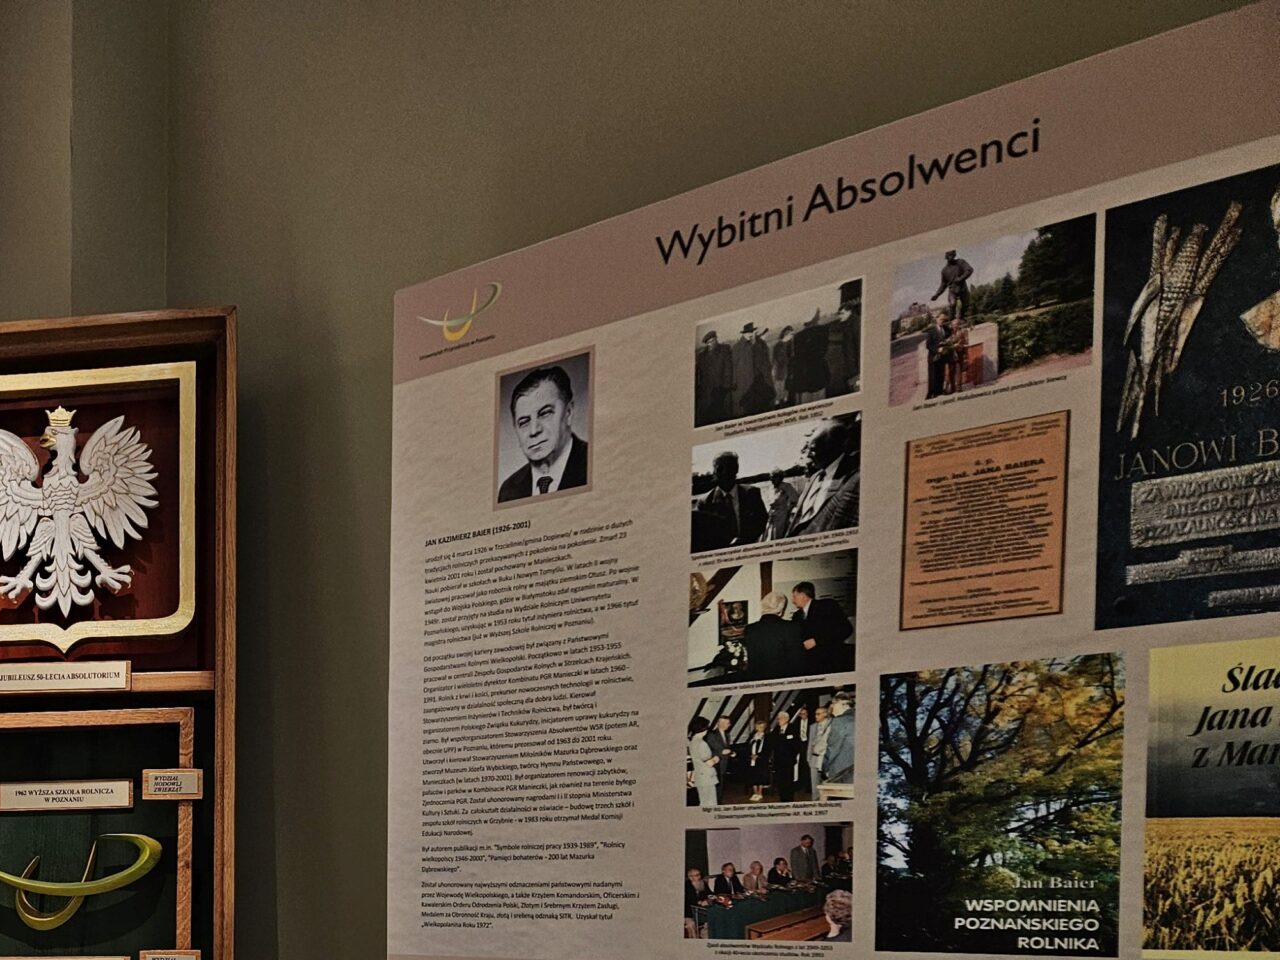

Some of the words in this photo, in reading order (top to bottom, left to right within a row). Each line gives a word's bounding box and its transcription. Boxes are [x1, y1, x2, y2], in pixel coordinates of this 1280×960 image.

[656, 196, 794, 265] Wybitni
[804, 118, 1042, 221] Absolwenci
[1115, 434, 1237, 481] JANOWI
[425, 539, 437, 547] JAN
[438, 532, 471, 545] KAZIMIERZ
[492, 520, 530, 536] (1926-2001)
[0, 674, 35, 682] JUBILEUSZ
[37, 673, 66, 681] 50-LECIA
[66, 672, 120, 680] ABSOLUTORIUM
[1187, 706, 1274, 737] Jana
[28, 788, 54, 796] WYŻSZA
[1012, 877, 1043, 889] Jan
[1049, 877, 1098, 889] Baier
[966, 899, 1099, 912] WSPOMNIENIA
[954, 915, 1099, 931] POZNAŃSKIEGO
[1018, 937, 1099, 950] ROLNIKA
